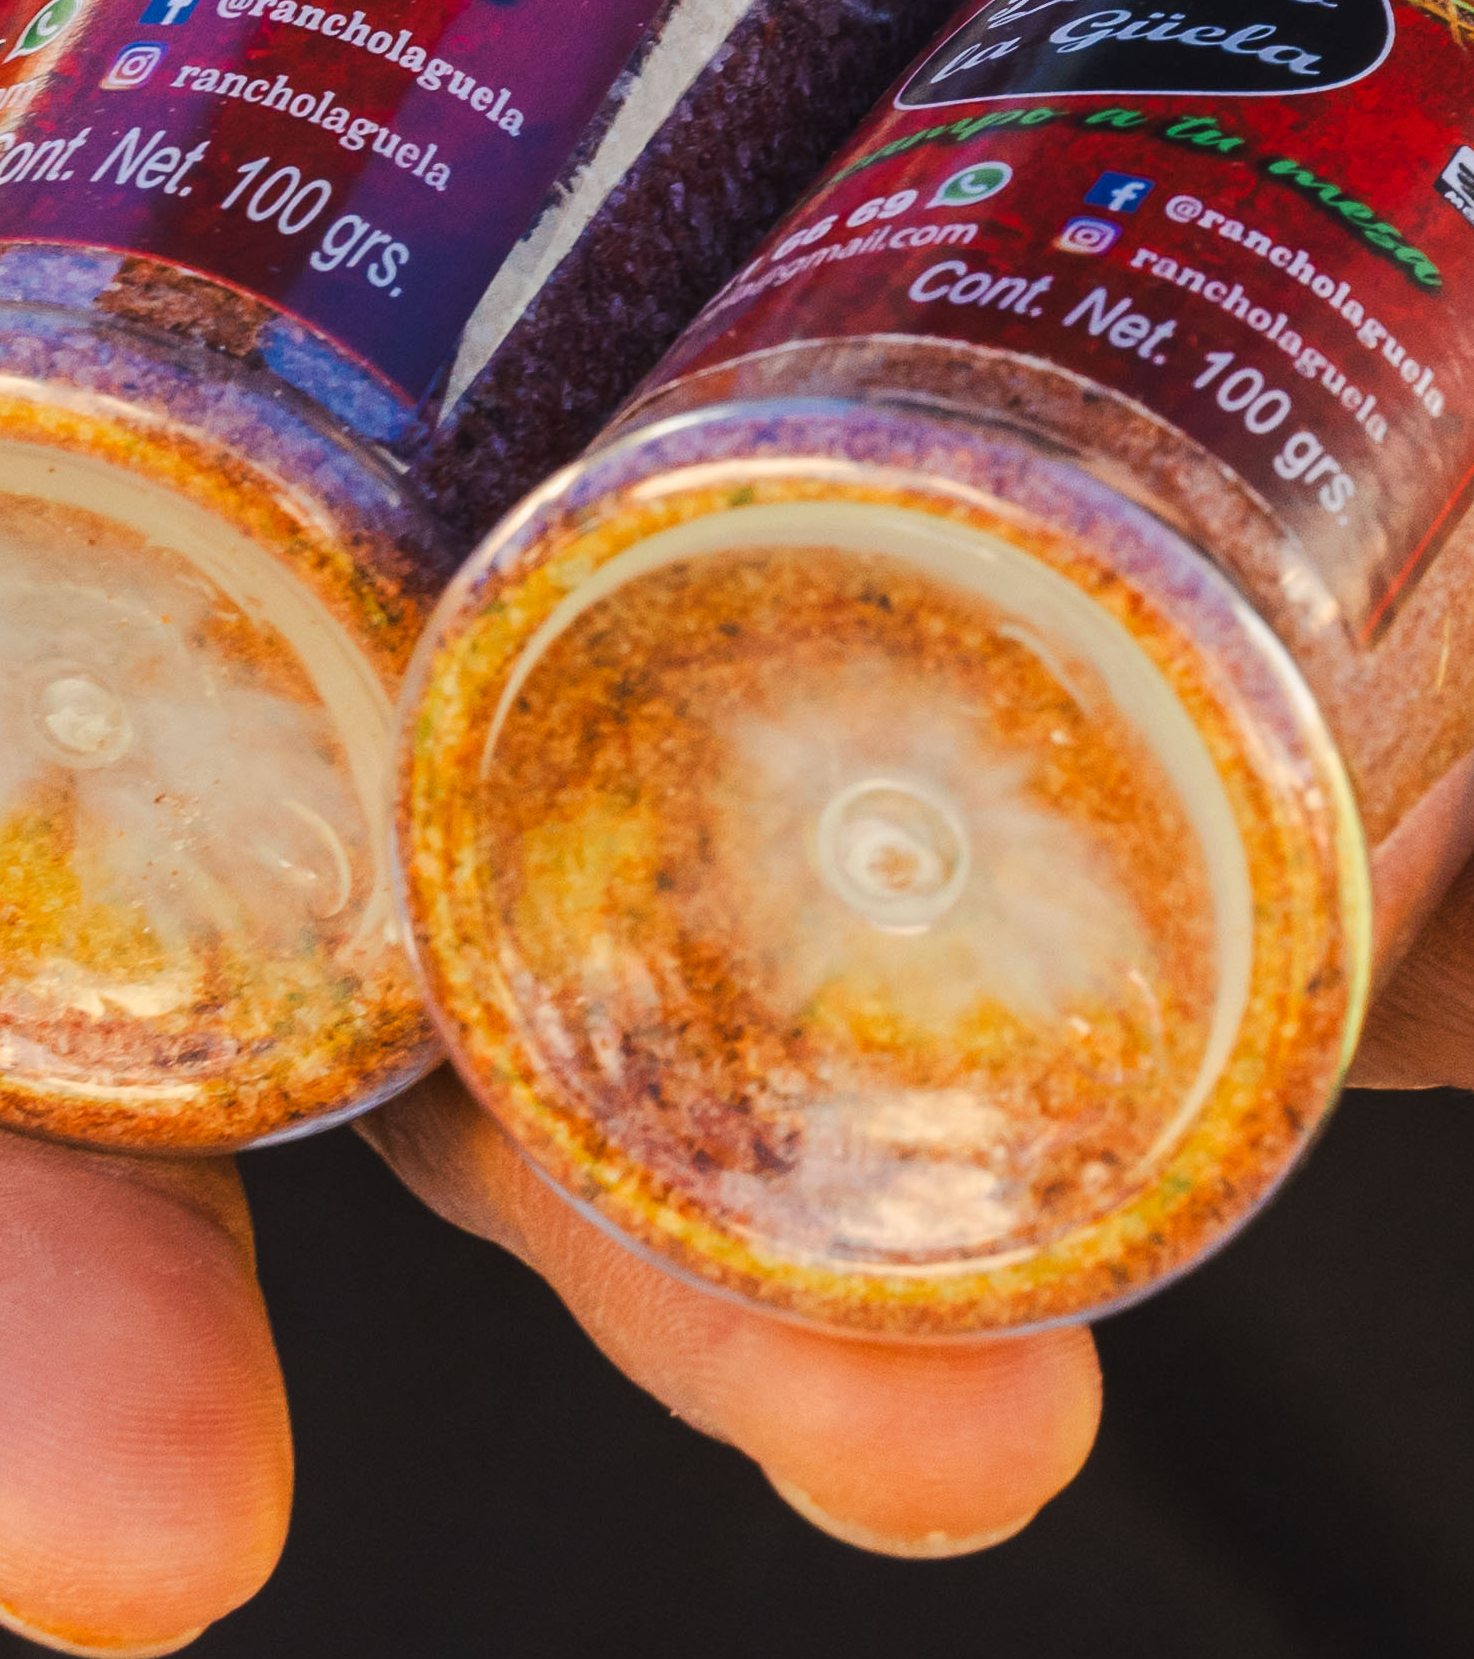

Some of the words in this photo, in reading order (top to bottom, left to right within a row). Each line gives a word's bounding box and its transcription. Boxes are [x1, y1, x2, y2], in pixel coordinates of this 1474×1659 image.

[170, 61, 452, 191] rancholaguela
[1049, 10, 1326, 76] Güela
[91, 126, 210, 197] Net.
[220, 156, 332, 236] 100
[309, 214, 411, 298] grs.
[846, 189, 919, 228] 69
[1083, 108, 1155, 128] a
[1166, 114, 1245, 153] tu
[1268, 157, 1444, 288] mesa
[907, 259, 1055, 318] Cont.
[1062, 286, 1177, 366] Net.
[1193, 350, 1293, 436] 100
[1272, 430, 1357, 528] grs.
[1129, 246, 1388, 444] rancholaguela
[1164, 193, 1446, 419] @rancholaguela
